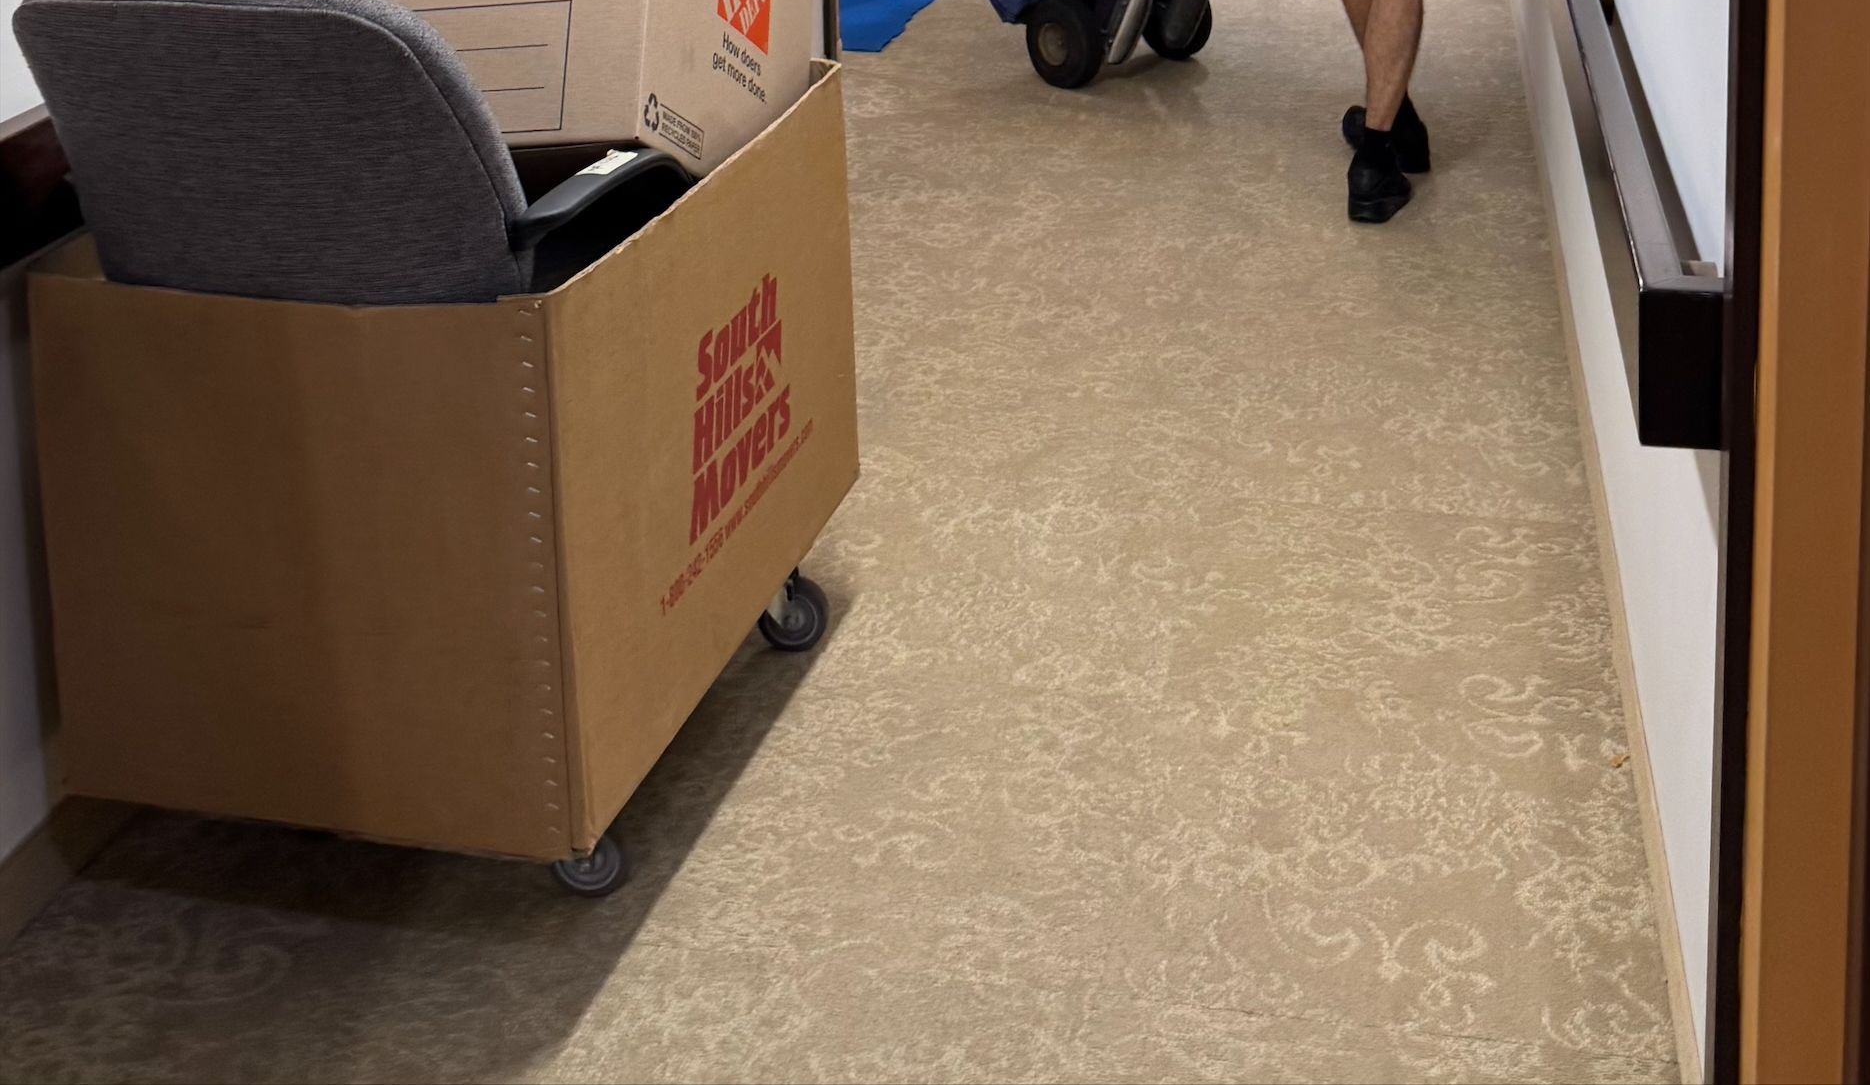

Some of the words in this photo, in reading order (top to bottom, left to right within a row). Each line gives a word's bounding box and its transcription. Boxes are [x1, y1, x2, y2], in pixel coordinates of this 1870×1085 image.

[712, 52, 726, 71] get
[727, 63, 747, 87] more
[748, 78, 768, 105] done.
[722, 31, 740, 58] How
[741, 47, 761, 76] doers
[696, 272, 777, 402] South
[689, 383, 791, 547] Movers
[693, 362, 755, 476] Hills
